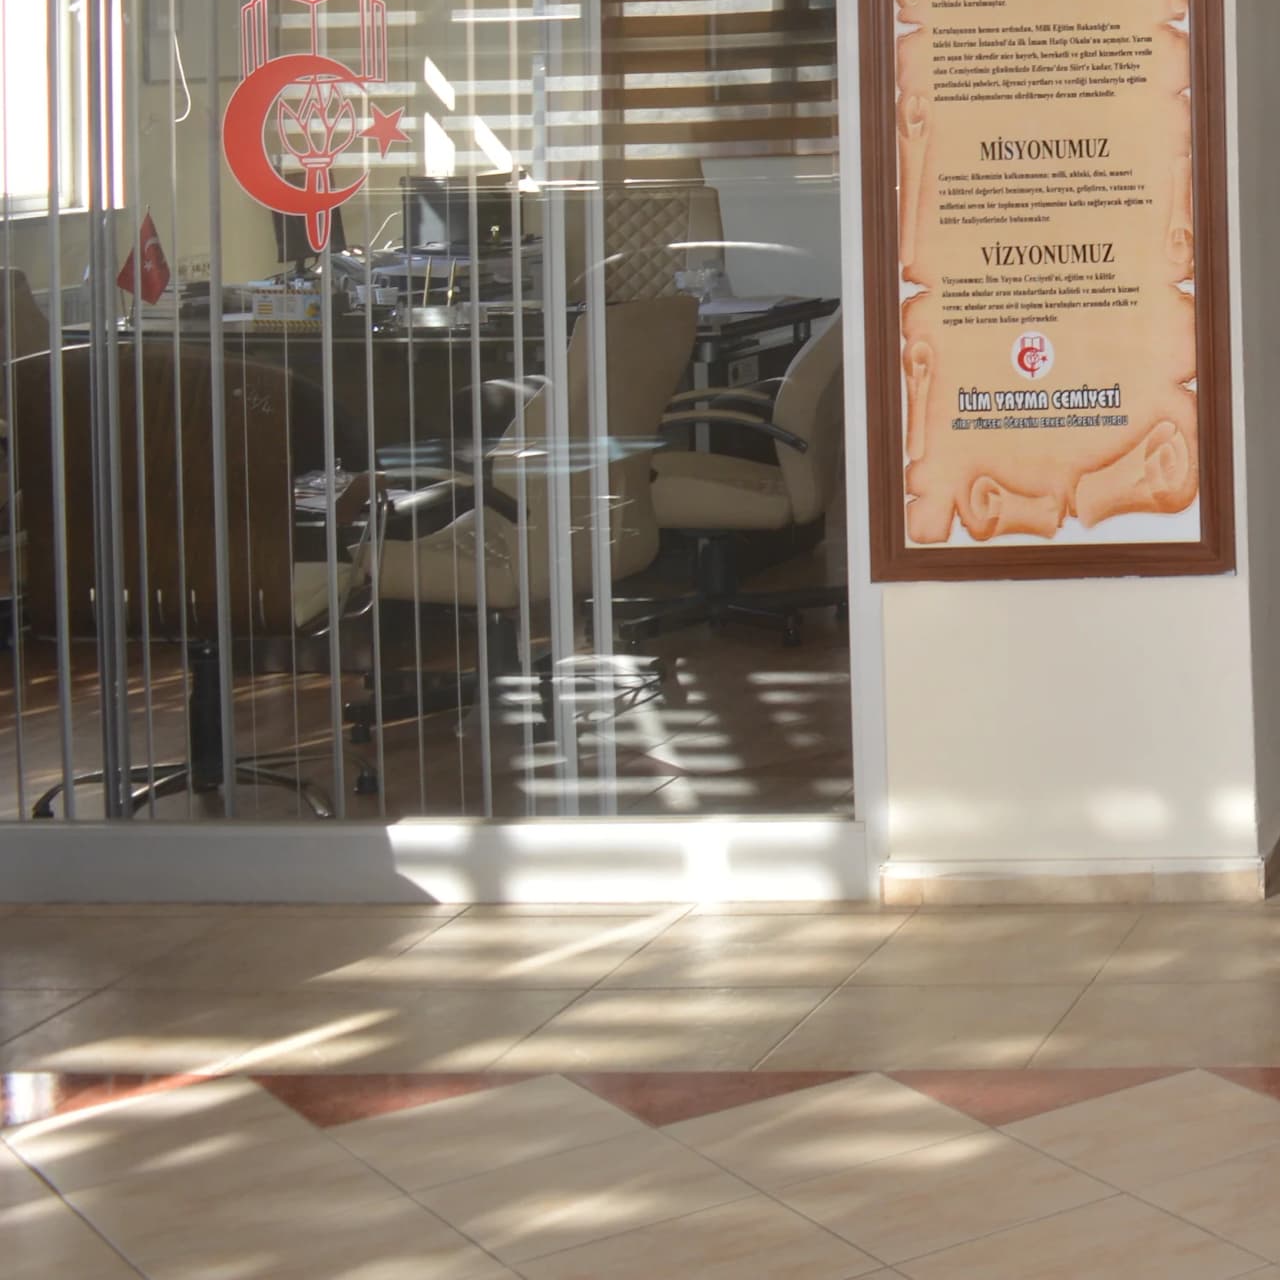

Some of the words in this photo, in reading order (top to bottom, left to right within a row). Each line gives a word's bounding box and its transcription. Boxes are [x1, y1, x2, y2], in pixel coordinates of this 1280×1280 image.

[980, 136, 1110, 161] MİSYONUMUZ
[981, 241, 1115, 266] VİZYONUMUZ
[958, 387, 992, 412] İLİM
[995, 390, 1049, 411] YAYMA
[1052, 384, 1121, 409] CEMİYETİ
